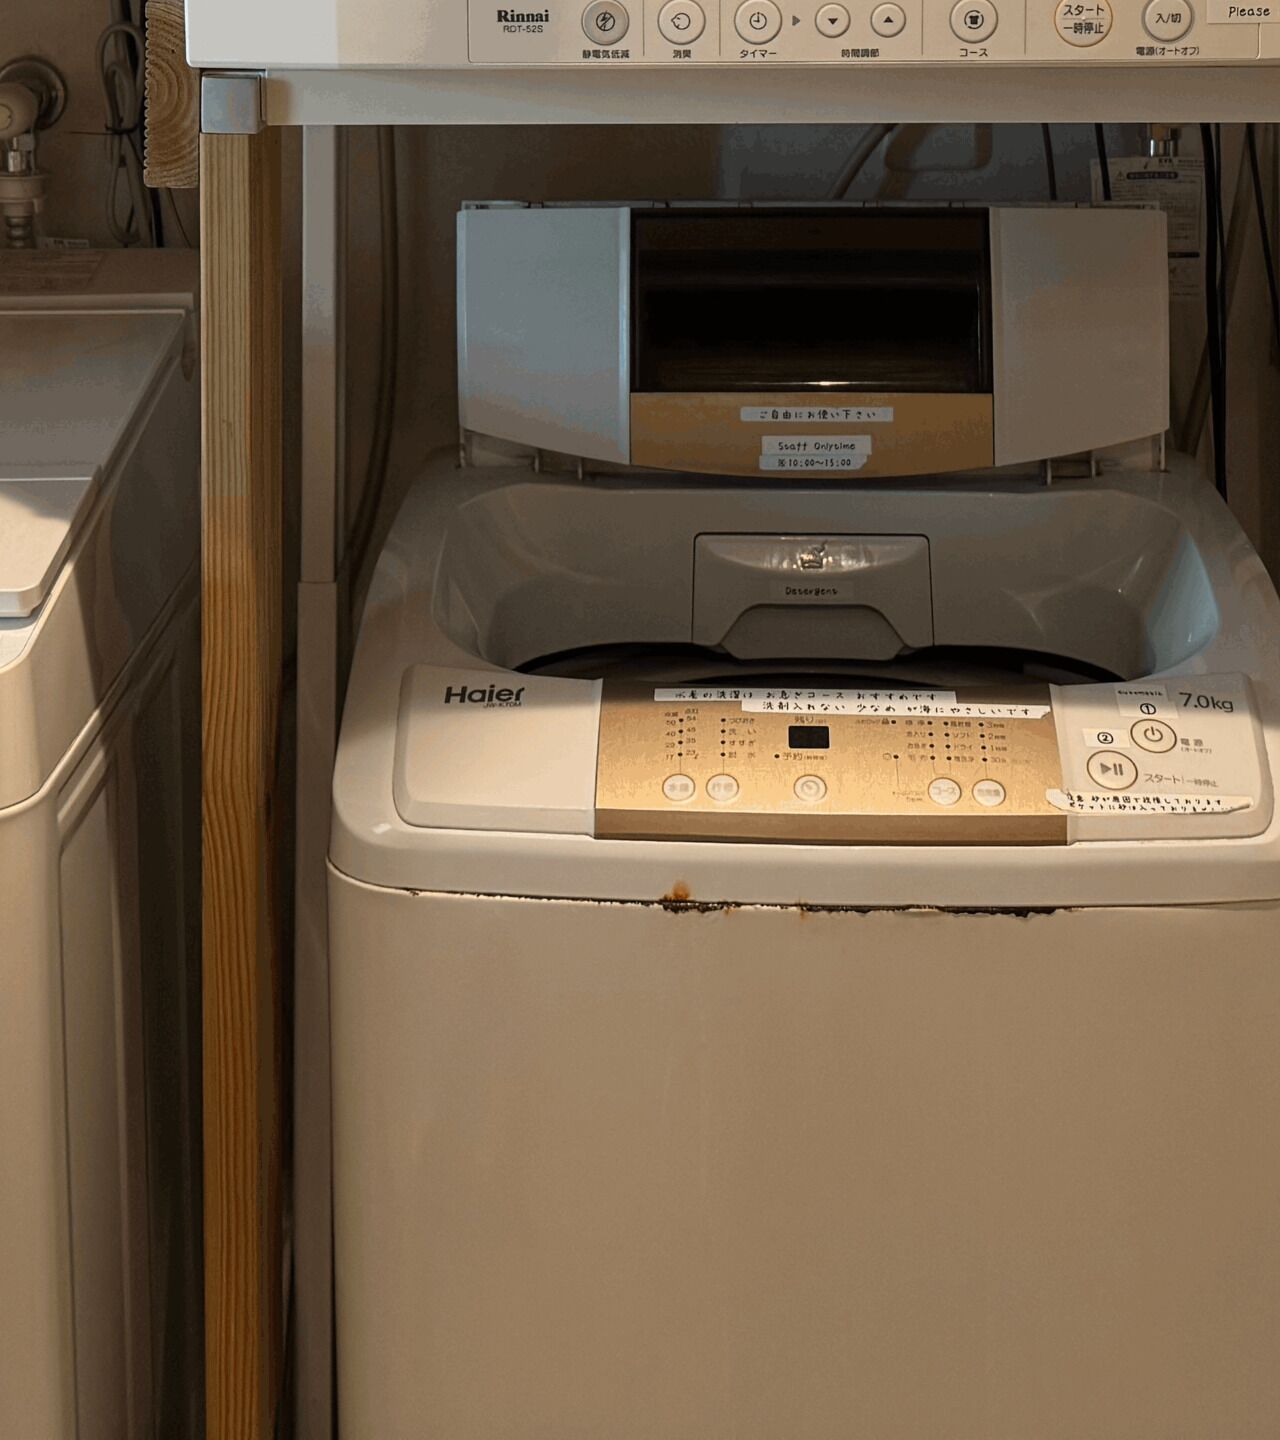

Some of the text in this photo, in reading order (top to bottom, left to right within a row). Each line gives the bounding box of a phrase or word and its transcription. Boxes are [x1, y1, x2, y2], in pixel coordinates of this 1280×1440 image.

[496, 9, 549, 22] Rinnai
[1063, 4, 1105, 16] スタート
[1228, 5, 1271, 18] Please
[1155, 12, 1181, 24] 入/切
[503, 24, 544, 33] RDT-52S
[1063, 22, 1104, 35] 一時停止
[582, 49, 630, 59] 静電気低減
[739, 49, 777, 58] タイマー
[841, 48, 879, 58] 時間調節
[959, 48, 988, 58] コース
[1136, 45, 1199, 56] 電源(オートオフ)
[759, 409, 876, 420] ご自由にお使い下さい
[778, 441, 807, 451] Staff
[785, 586, 838, 597] Detergent
[444, 684, 525, 704] Haier
[1178, 691, 1234, 713] 7.0kg
[1144, 773, 1181, 785] スタート
